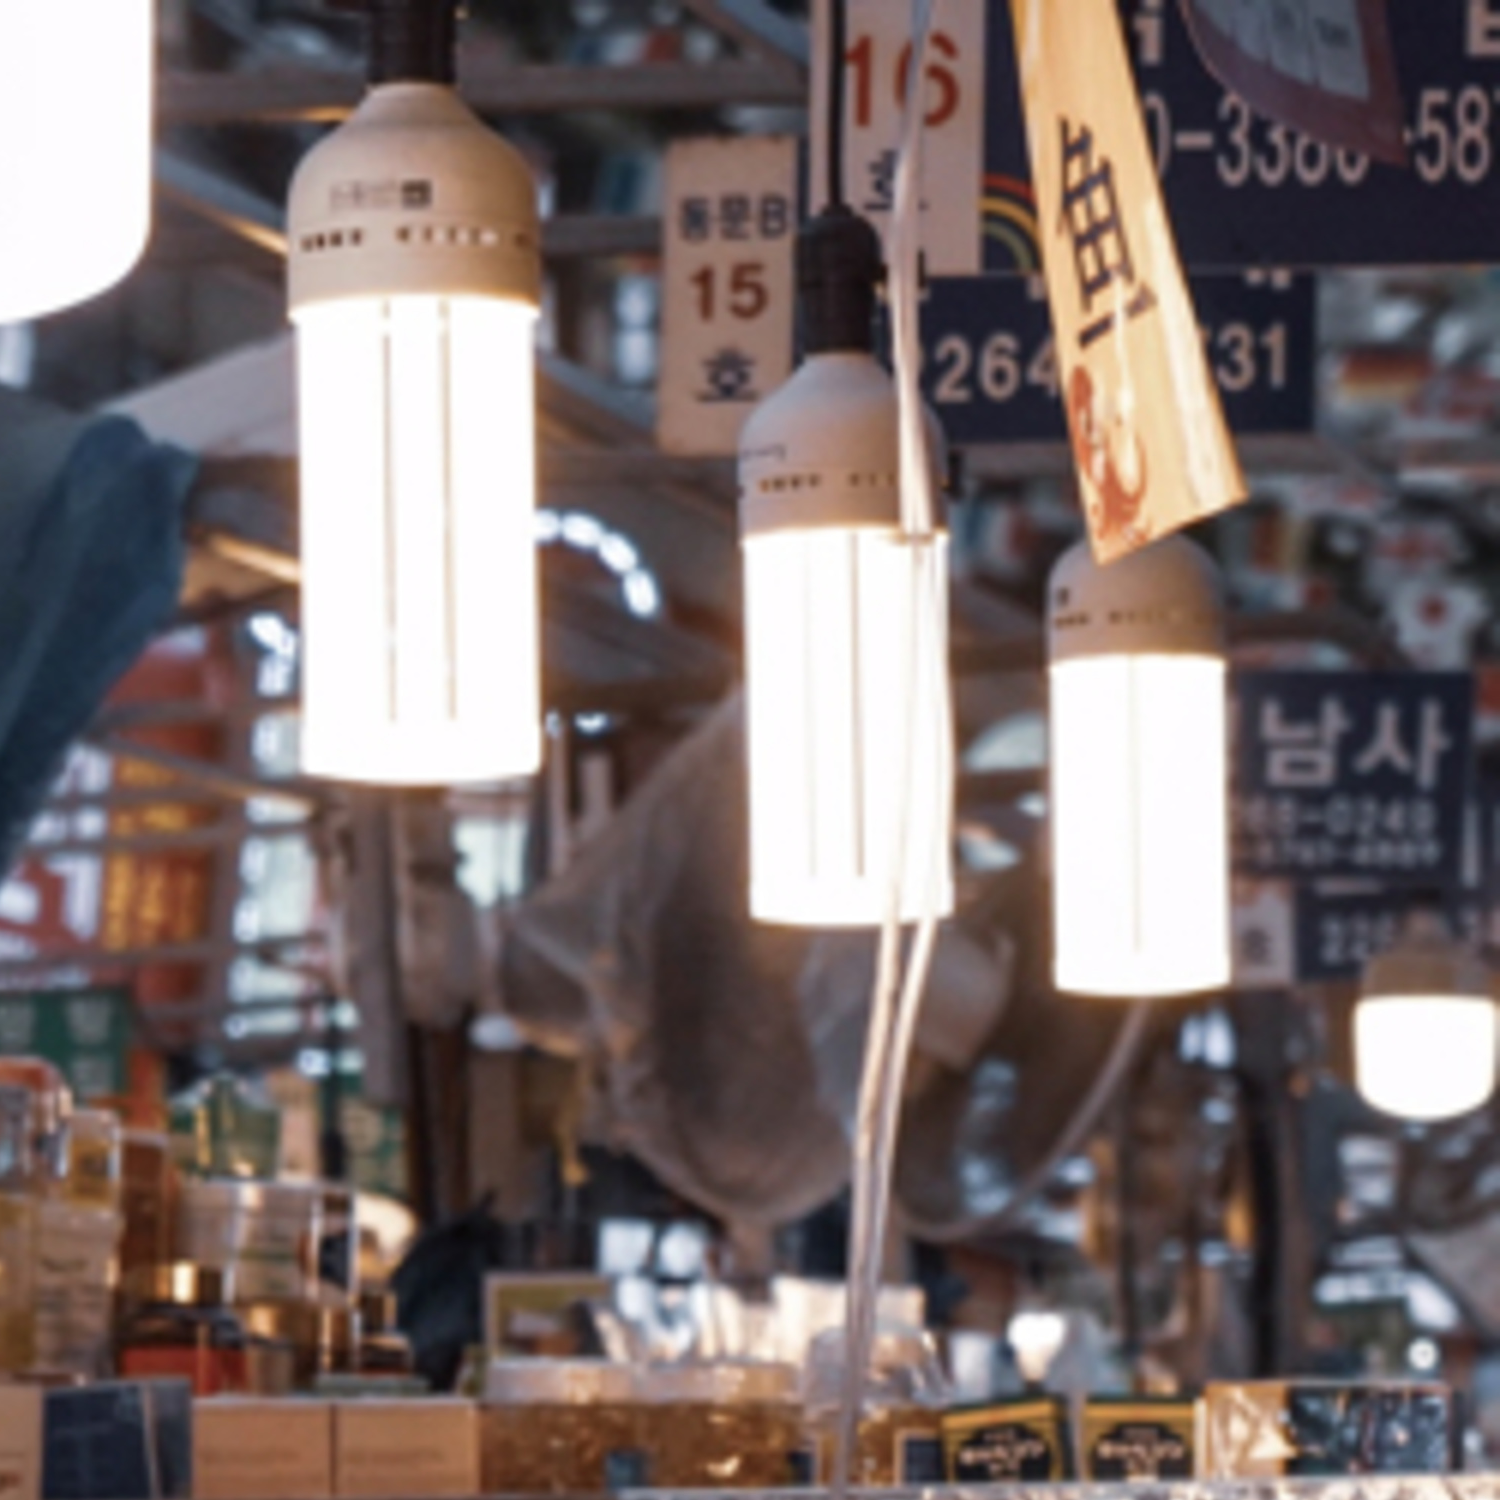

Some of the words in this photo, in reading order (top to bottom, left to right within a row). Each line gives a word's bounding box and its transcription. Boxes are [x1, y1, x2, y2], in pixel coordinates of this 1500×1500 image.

[845, 32, 959, 128] 16
[690, 263, 770, 322] 15
[1262, 697, 1452, 789] 남사
